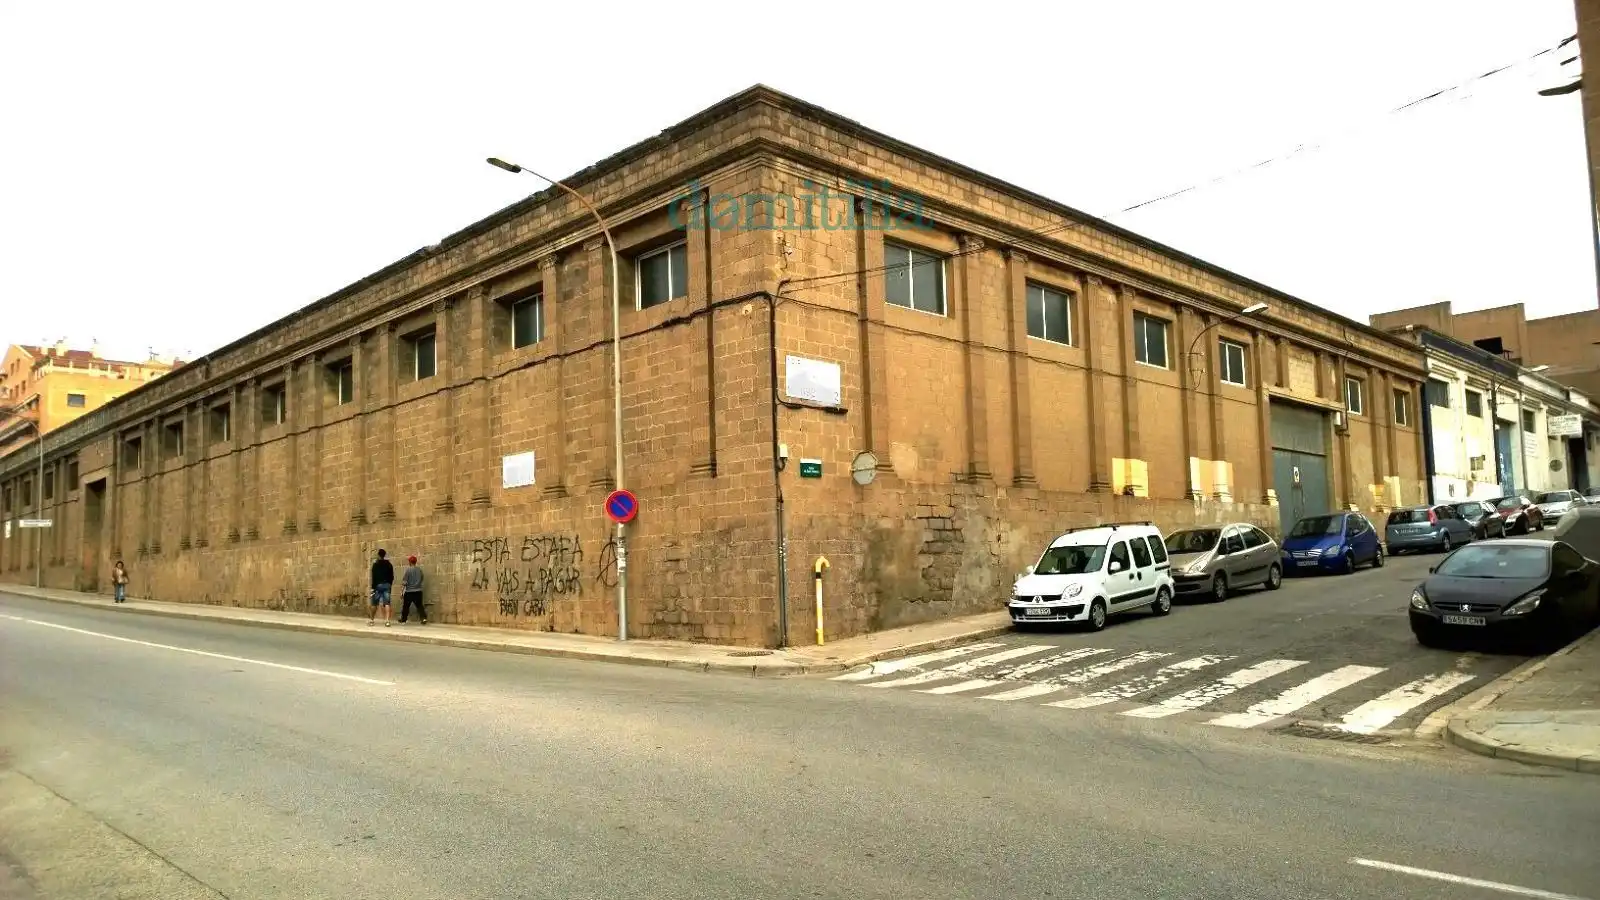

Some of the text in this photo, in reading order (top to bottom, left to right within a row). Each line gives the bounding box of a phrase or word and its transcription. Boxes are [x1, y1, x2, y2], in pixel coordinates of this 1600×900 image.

[472, 534, 583, 564] ESTA ESTAFA
[472, 567, 489, 590] LA
[524, 568, 535, 594] A
[539, 566, 583, 595] PAGAR
